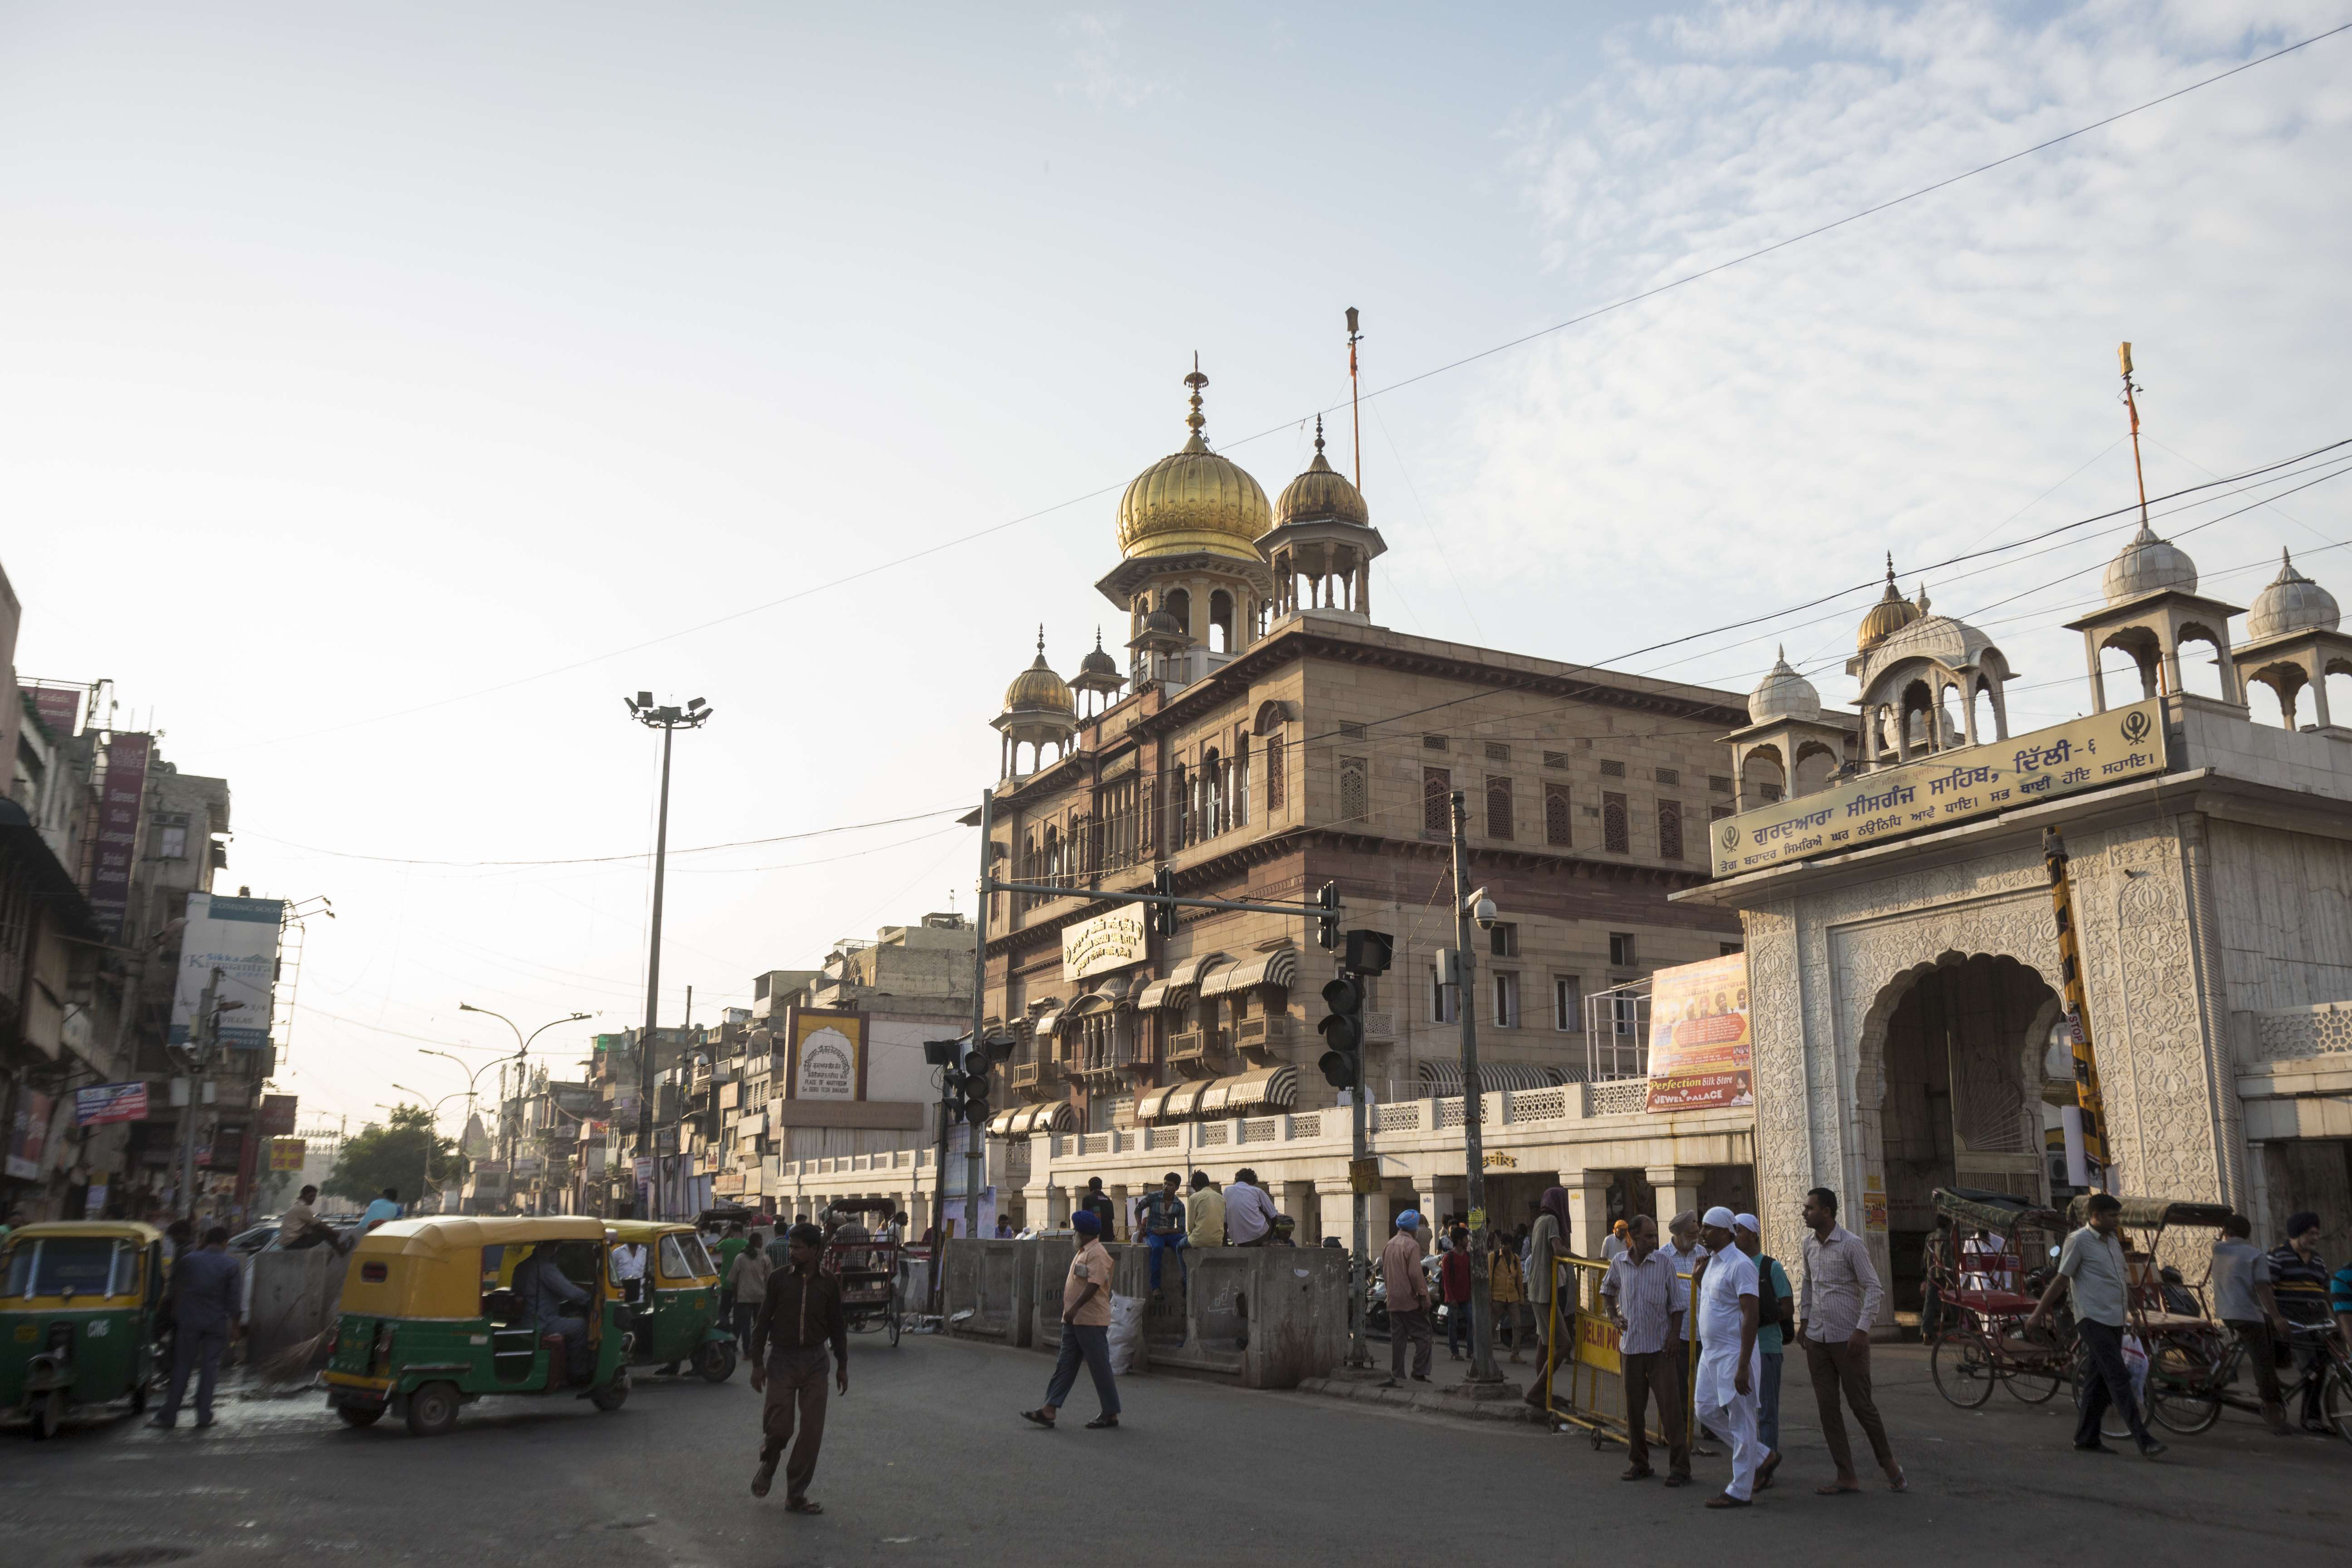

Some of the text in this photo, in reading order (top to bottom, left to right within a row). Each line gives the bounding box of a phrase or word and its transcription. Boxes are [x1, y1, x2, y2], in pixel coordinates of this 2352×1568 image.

[1752, 808, 1834, 846] ਗੁਰਦੁਆਰਾ
[1846, 785, 1916, 817] ਸੀਸਗੰਜ
[1929, 766, 1999, 795] ਸਾਹਿਬ,
[1720, 860, 1738, 872] ਤੇਗ
[1744, 849, 1777, 866] ਬਹਾਦਰ
[1784, 835, 1823, 856] ਸਿਮਰਿਐ
[1831, 829, 1850, 842] ਘਰ
[1857, 816, 1903, 836] ਨਉਨਿਧਿ
[1910, 805, 1936, 821] ਆਵੈ
[1989, 789, 2011, 802] ਸਭ
[2061, 767, 2091, 785] ਹੋਇ
[210, 901, 254, 912] COMING
[1123, 936, 1137, 946] DELHI
[206, 953, 240, 962] Sikka
[2068, 1016, 2083, 1041] STOP
[1649, 1076, 1733, 1092] Perfection Silk Store
[1654, 1089, 1723, 1104] JEWEL PALACE
[87, 1319, 110, 1338] CNG
[1583, 1319, 1604, 1348] DELHI
